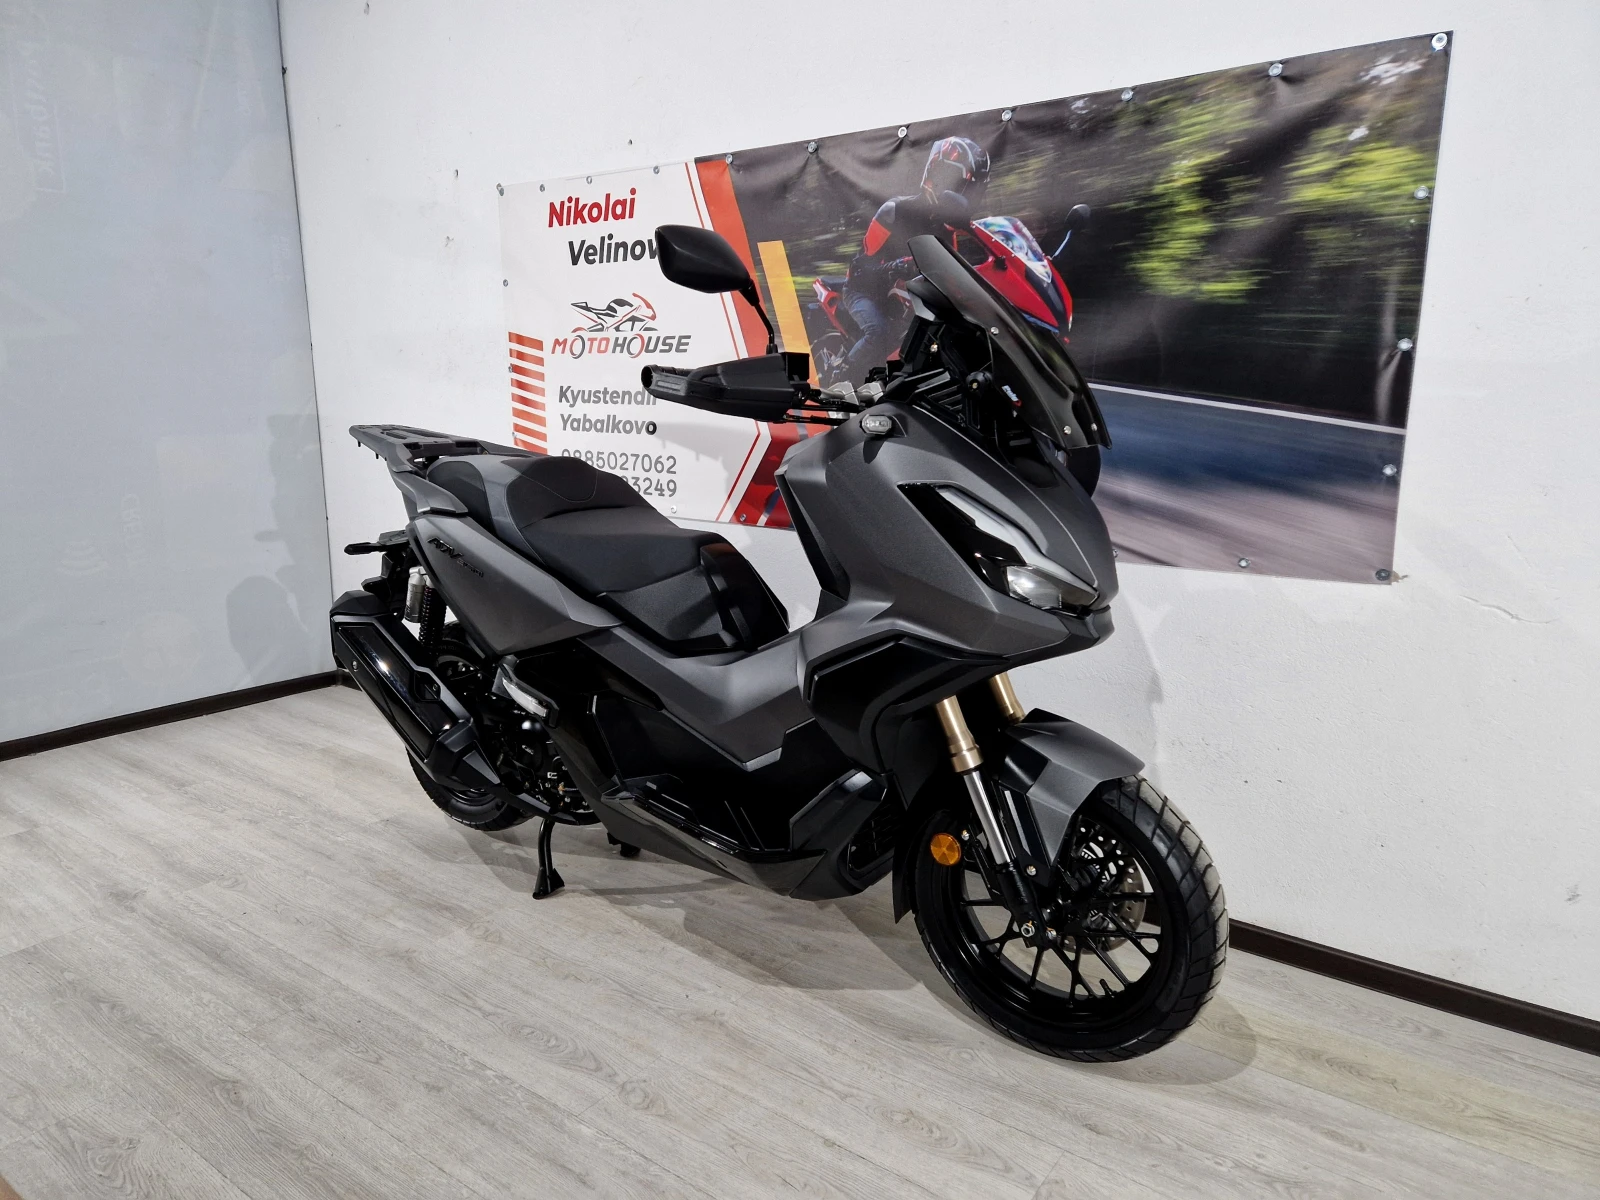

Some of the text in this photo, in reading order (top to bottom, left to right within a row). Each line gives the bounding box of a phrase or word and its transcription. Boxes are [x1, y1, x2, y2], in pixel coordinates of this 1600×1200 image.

[548, 187, 637, 228] Nikolai
[568, 233, 658, 266] Velinov
[560, 413, 657, 436] Yabalkovo
